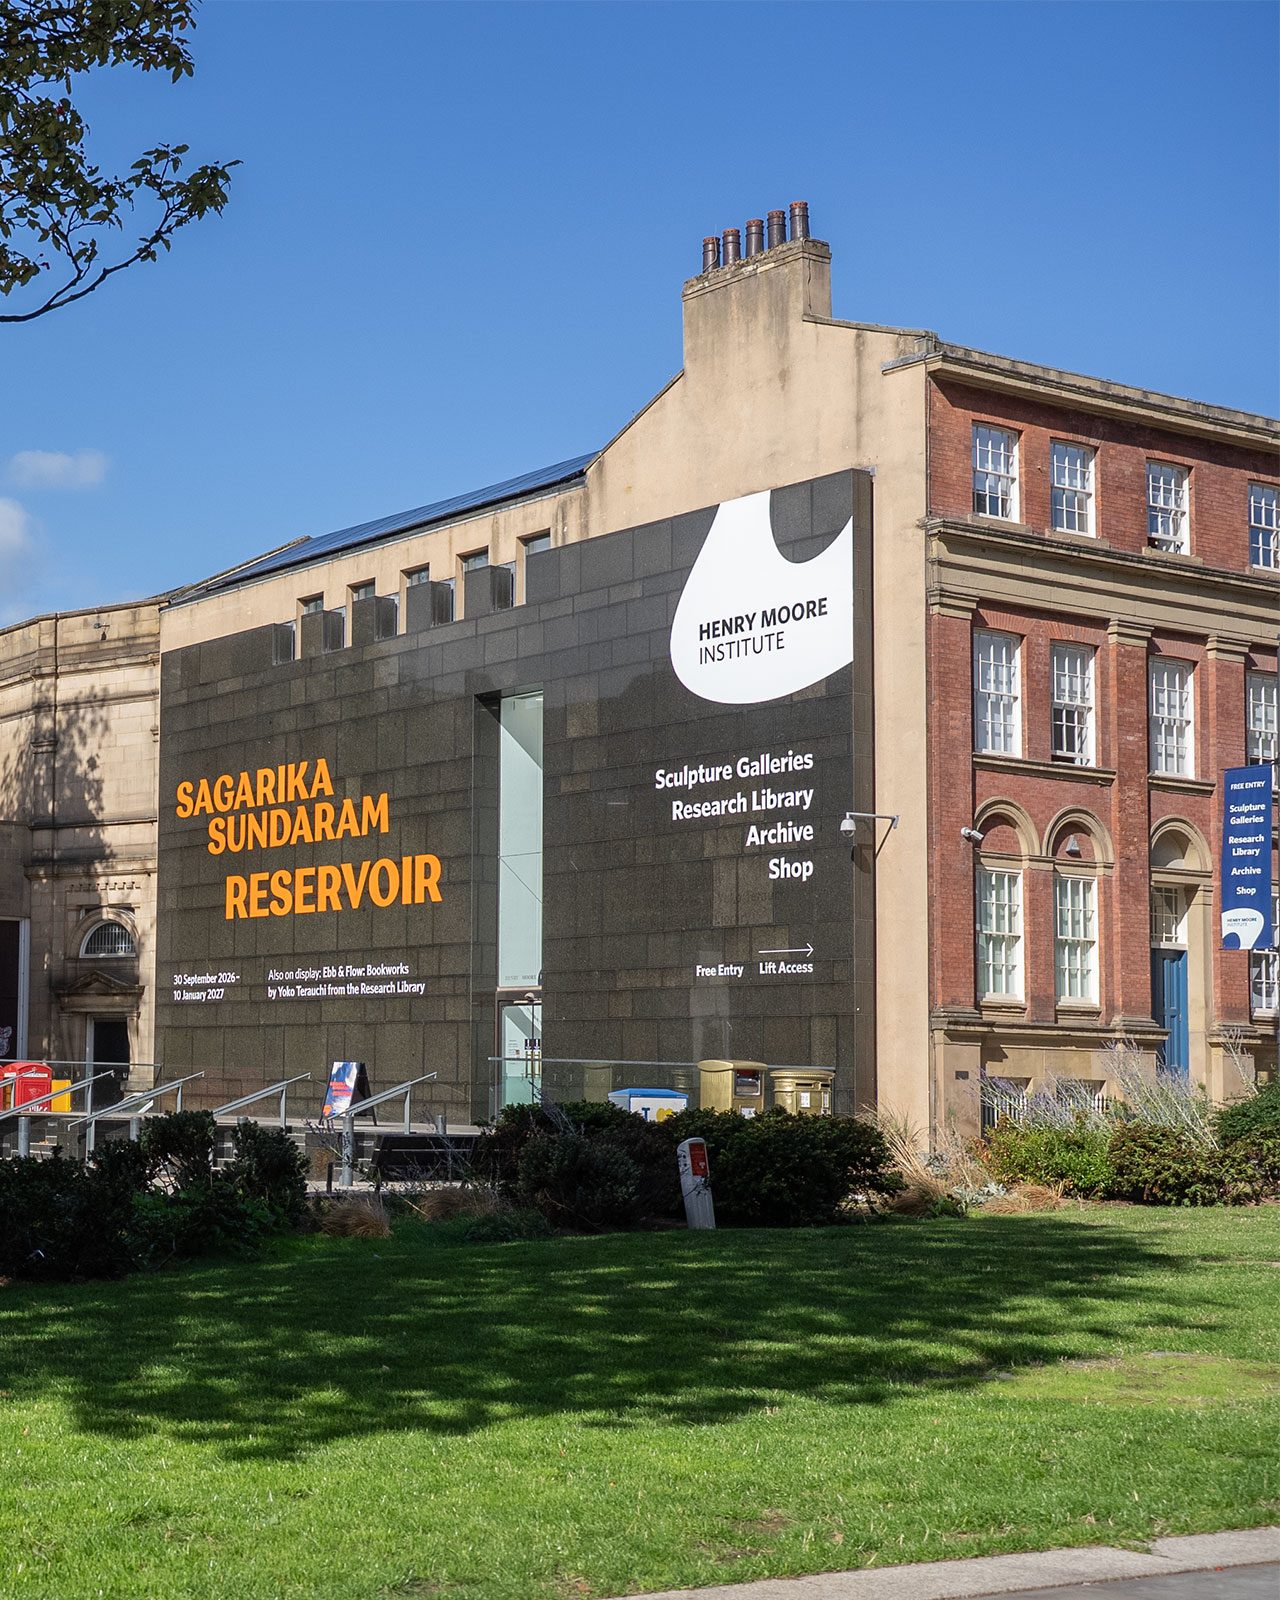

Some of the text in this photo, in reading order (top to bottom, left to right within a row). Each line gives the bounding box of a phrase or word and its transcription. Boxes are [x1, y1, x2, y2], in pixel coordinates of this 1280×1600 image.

[698, 597, 828, 641] HENRY MOORE
[698, 630, 786, 665] INSTITUTE
[656, 750, 813, 789] Sculpture Galleries
[175, 758, 334, 818] SAGARIKA
[673, 788, 813, 820] Research Library
[1230, 804, 1265, 813] Sculpture
[208, 793, 389, 855] SUNDARAM
[1230, 815, 1264, 824] Galleries
[746, 821, 813, 846] Archive
[1229, 834, 1264, 844] Research
[1233, 848, 1260, 856] Library
[769, 857, 813, 881] Shop
[1231, 867, 1261, 875] Archive
[225, 854, 442, 920] RESERVOIR
[1237, 887, 1256, 895] Shop
[268, 969, 283, 980] Also
[294, 967, 321, 981] display:
[323, 966, 336, 978] Ebb
[338, 966, 344, 977] &
[346, 965, 365, 977] Flow:
[367, 963, 409, 976] Bookworks
[696, 963, 743, 978] Free Entry
[760, 962, 813, 974] Lift Access
[174, 975, 182, 985] 30
[183, 974, 217, 986] September
[174, 988, 224, 1001] 10 January 2027
[268, 981, 425, 999] by Yoko Terauchi from the Research Library
